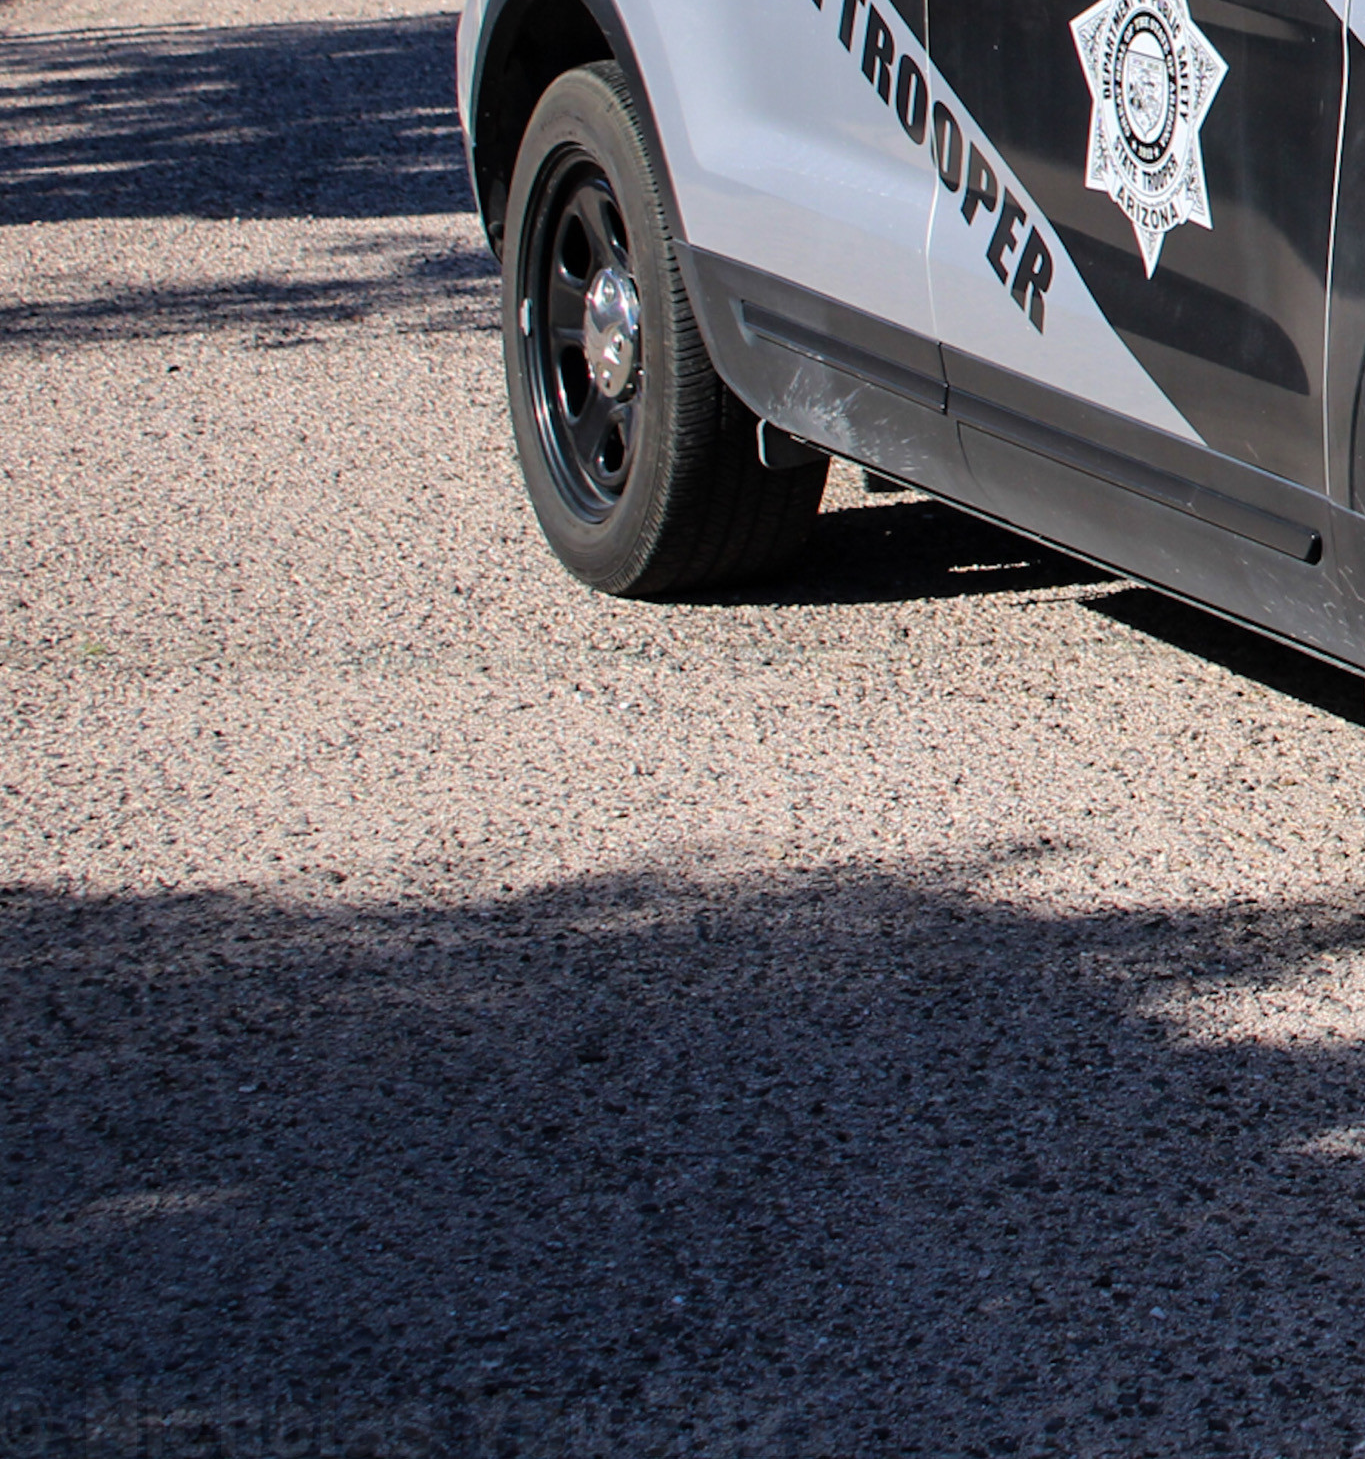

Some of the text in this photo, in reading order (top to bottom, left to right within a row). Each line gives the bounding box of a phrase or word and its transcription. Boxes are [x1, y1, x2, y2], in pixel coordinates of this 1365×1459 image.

[1176, 44, 1189, 123] SAFETY
[1113, 135, 1179, 193] STATE TROOPER
[1116, 185, 1179, 230] ARIZONA
